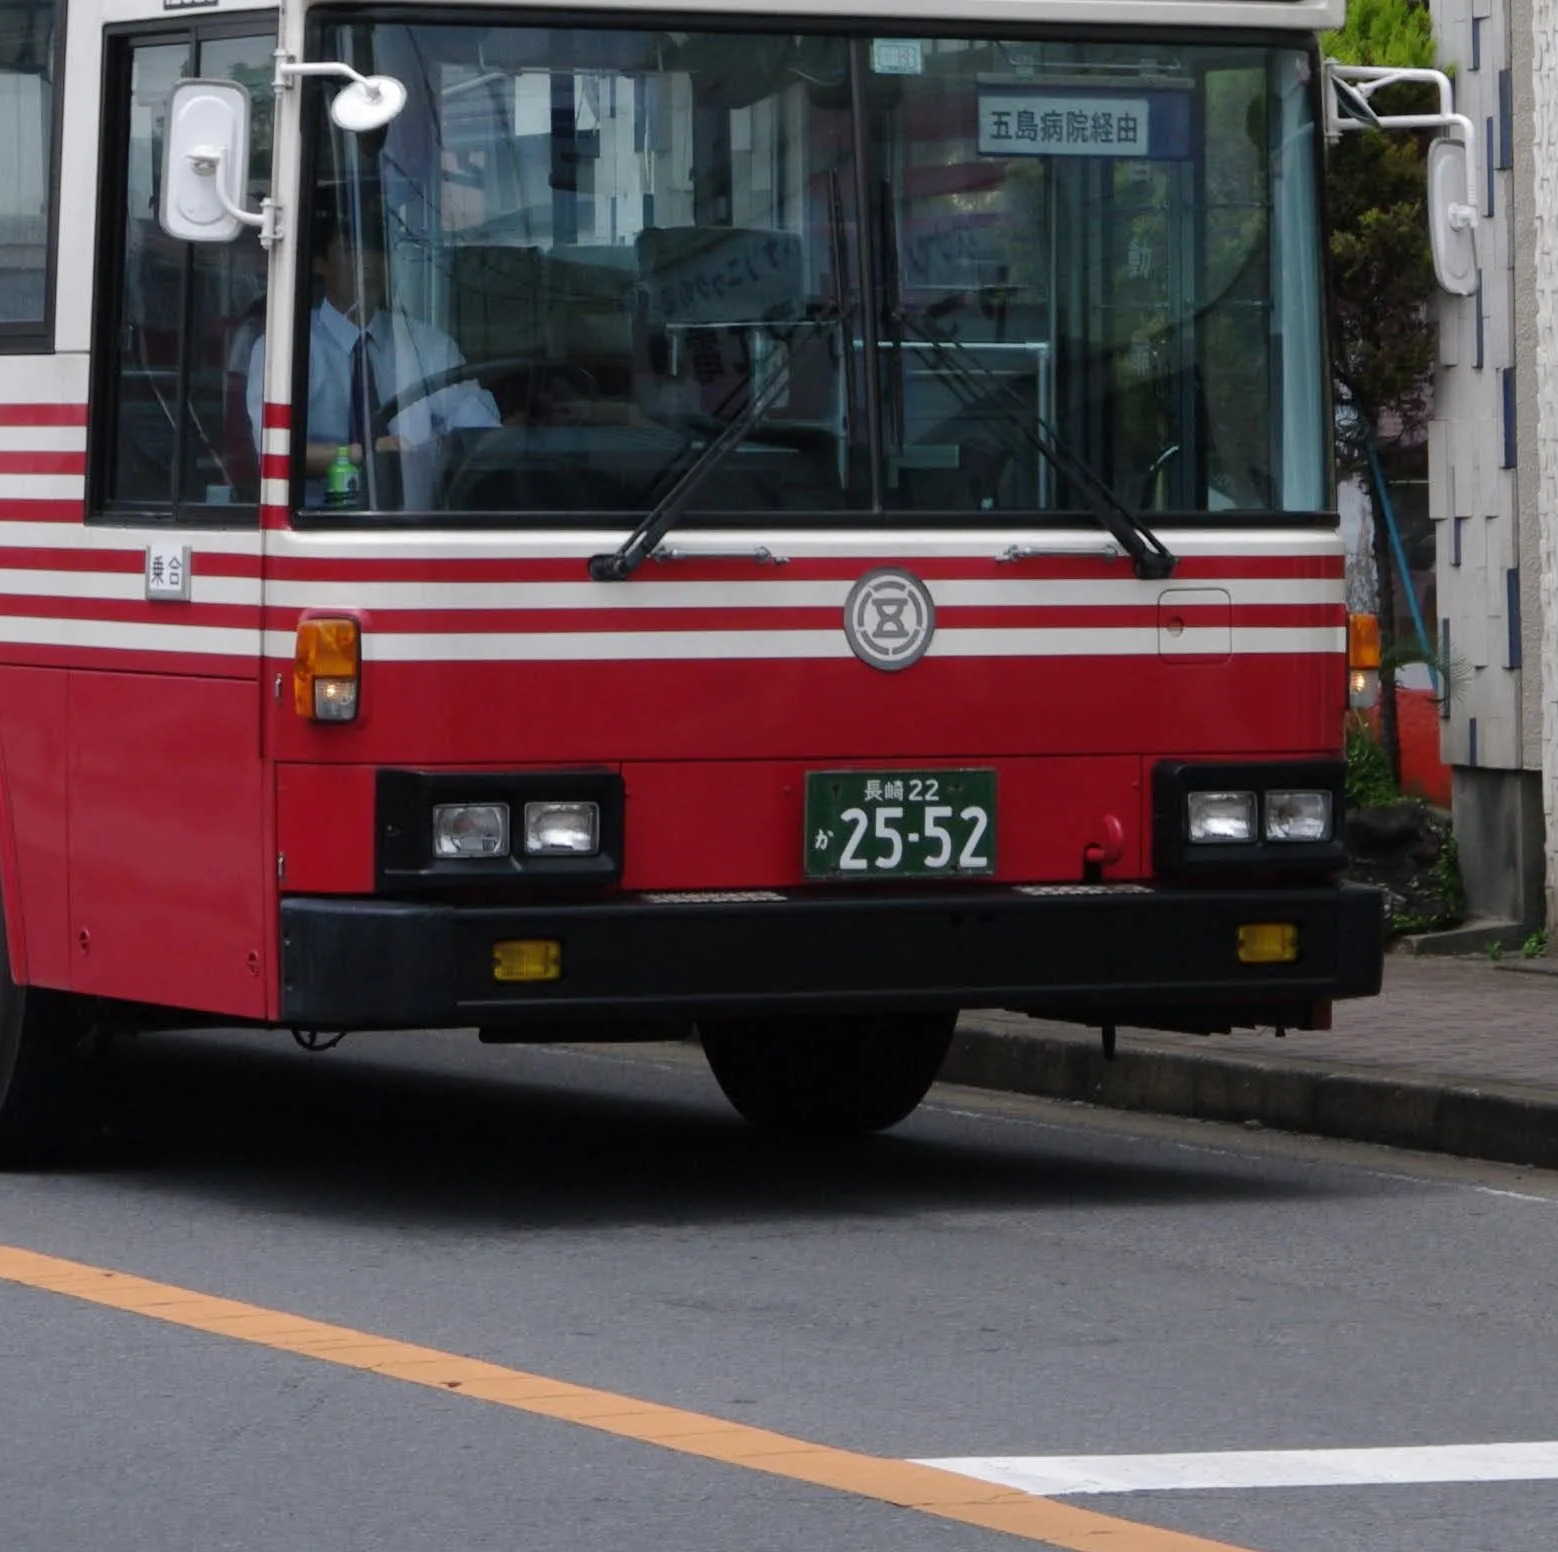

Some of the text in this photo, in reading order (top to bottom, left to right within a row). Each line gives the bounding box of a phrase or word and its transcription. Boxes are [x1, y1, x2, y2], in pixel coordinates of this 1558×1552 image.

[989, 109, 1139, 145] 五島病院経由
[151, 555, 182, 586] 乗合
[864, 779, 939, 801] 長崎 22
[839, 806, 988, 870] 25-52
